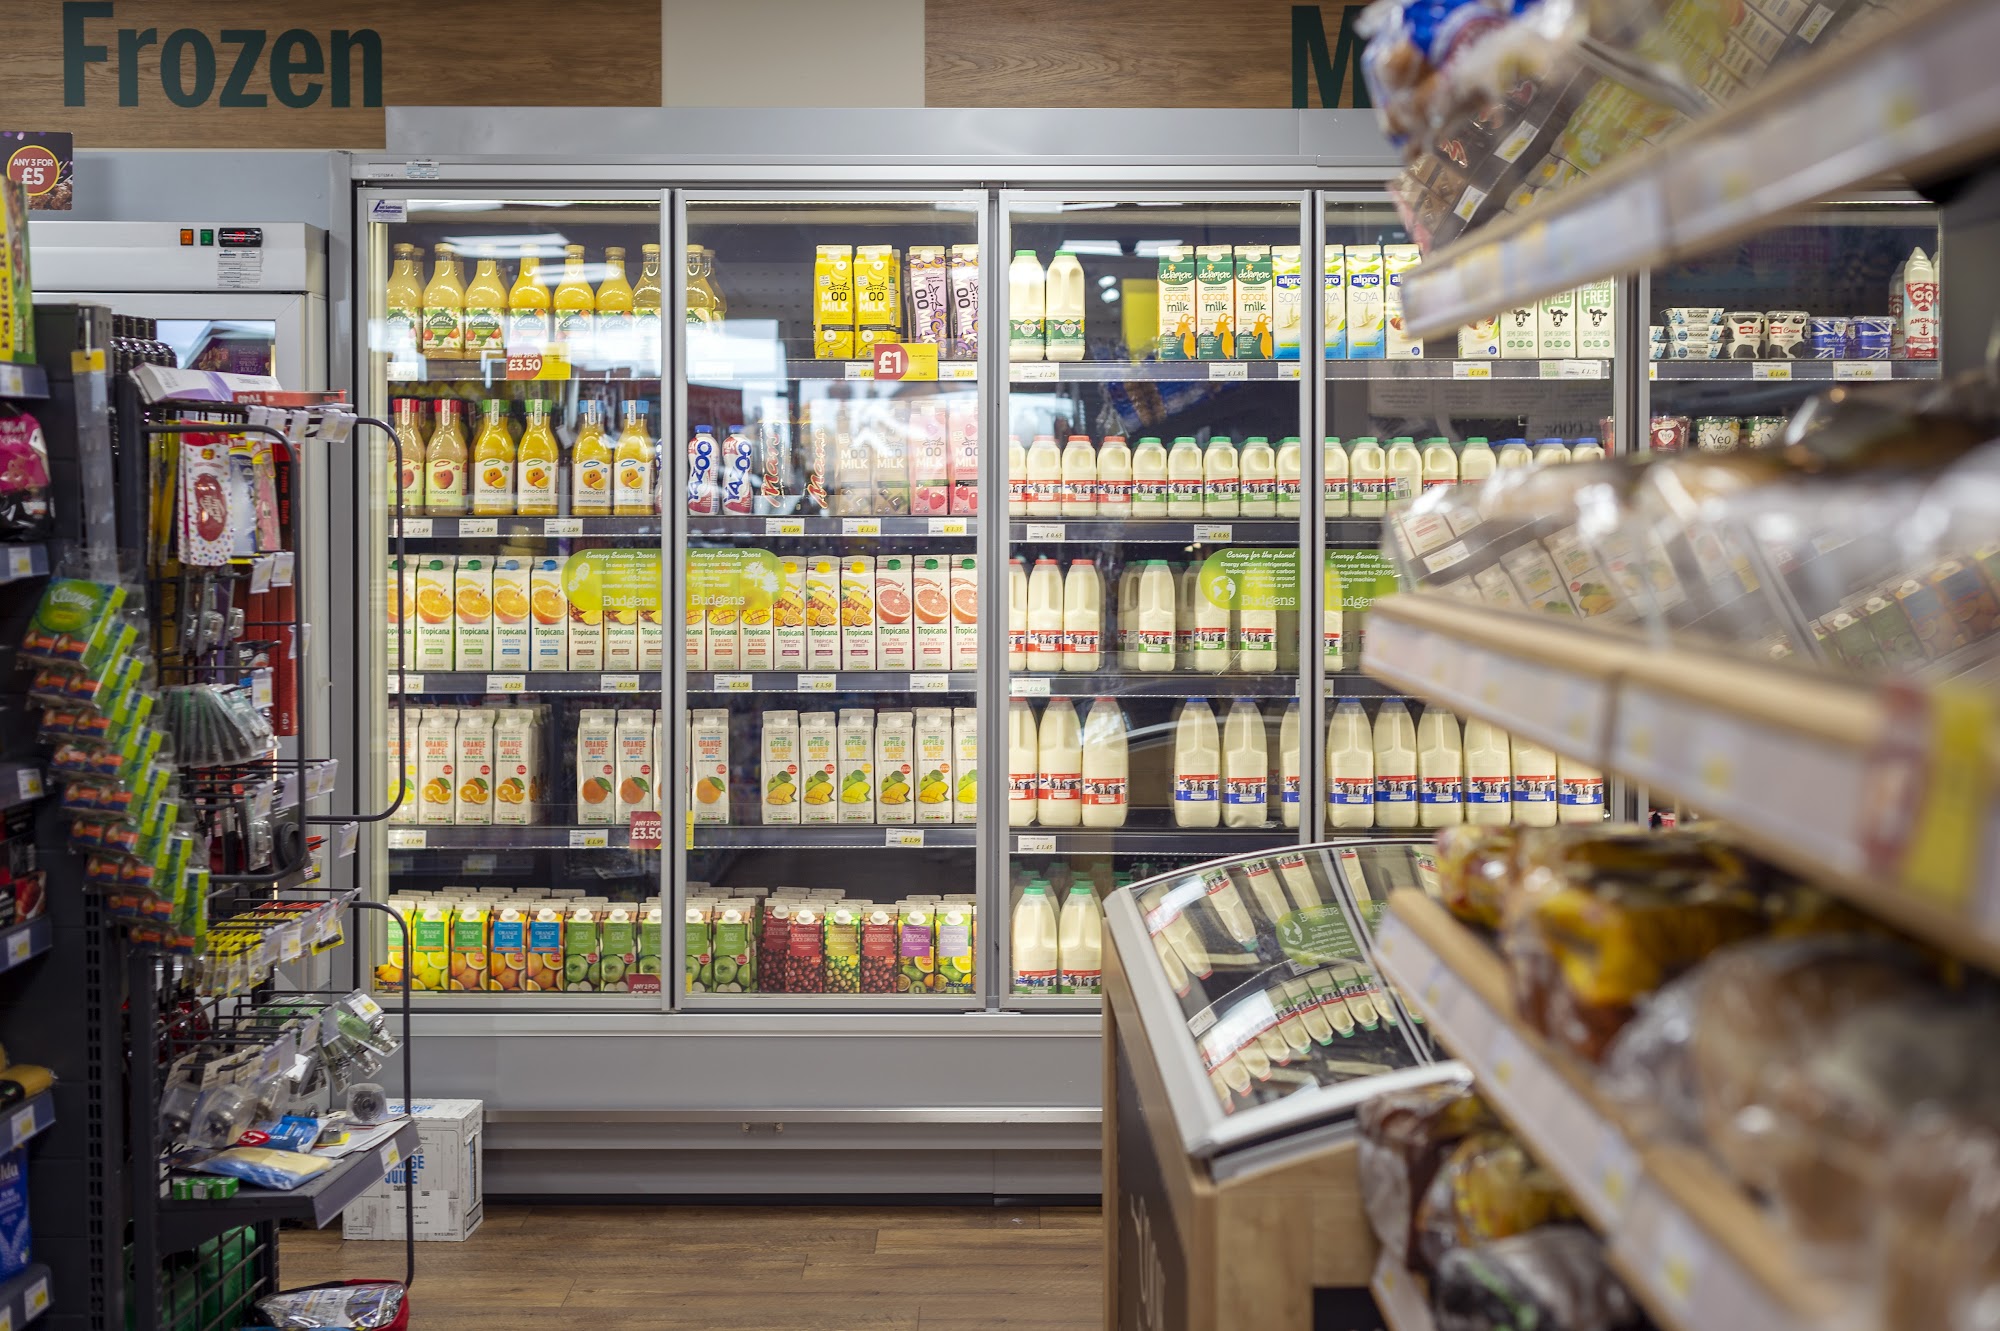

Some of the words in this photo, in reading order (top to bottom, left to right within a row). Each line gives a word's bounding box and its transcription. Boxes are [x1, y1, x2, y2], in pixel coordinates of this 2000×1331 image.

[63, 1, 383, 108] Frozen
[13, 158, 31, 167] ANY
[31, 158, 37, 167] 3
[37, 159, 54, 167] FOR
[22, 167, 45, 186] £5
[1161, 268, 1193, 281] delamere
[1199, 268, 1231, 281] delamere
[1238, 268, 1270, 281] delamere
[1353, 276, 1378, 286] alpro
[821, 291, 847, 302] MOO
[859, 291, 884, 302] MOO
[1164, 293, 1190, 304] goats
[1202, 293, 1228, 304] goats
[1241, 293, 1268, 304] goats
[1353, 292, 1378, 302] SOYA
[1584, 290, 1610, 305] FREE
[821, 301, 848, 312] MILK
[859, 301, 886, 312] MILK
[1167, 302, 1189, 312] milk
[1205, 302, 1227, 312] milk
[1244, 302, 1266, 312] milk
[430, 316, 454, 326] COPELLA
[472, 316, 496, 326] COPELLA
[518, 318, 542, 326] COPELLA
[562, 318, 586, 328] COPELLA
[508, 359, 542, 372] £3.50
[878, 350, 902, 374] £1
[1542, 362, 1556, 370] FREE
[1710, 434, 1731, 444] Yeo
[841, 449, 866, 459] MOO
[916, 447, 942, 457] MOO
[807, 428, 828, 508] Mars
[841, 460, 868, 469] MILK
[877, 459, 904, 469] MILK
[916, 458, 943, 468] MILK
[724, 440, 752, 502] YAZOO
[762, 433, 780, 508] Mars
[586, 552, 609, 560] Energy
[611, 552, 635, 560] Saving
[636, 552, 656, 560] Doors
[1226, 552, 1249, 560] Caring
[1250, 552, 1260, 560] for
[1273, 552, 1295, 560] planet
[1330, 552, 1352, 561] Energy
[1353, 552, 1379, 561] Saving
[603, 596, 656, 608] Budgens
[691, 594, 745, 607] Budgens
[1242, 595, 1295, 607] Budgens
[420, 627, 449, 636] Tropicana
[459, 627, 489, 636] Tropicana
[496, 627, 526, 636] Tropicana
[534, 628, 564, 636] Tropicana
[572, 628, 599, 636] Tropicana
[607, 628, 634, 636] Tropicana
[710, 628, 737, 636] Tropicana
[743, 628, 770, 636] Tropicana
[777, 629, 804, 637] Tropicana
[810, 629, 838, 637] Tropicana
[845, 629, 873, 637] Tropicana
[879, 627, 909, 635] Tropicana
[917, 627, 947, 635] Tropicana
